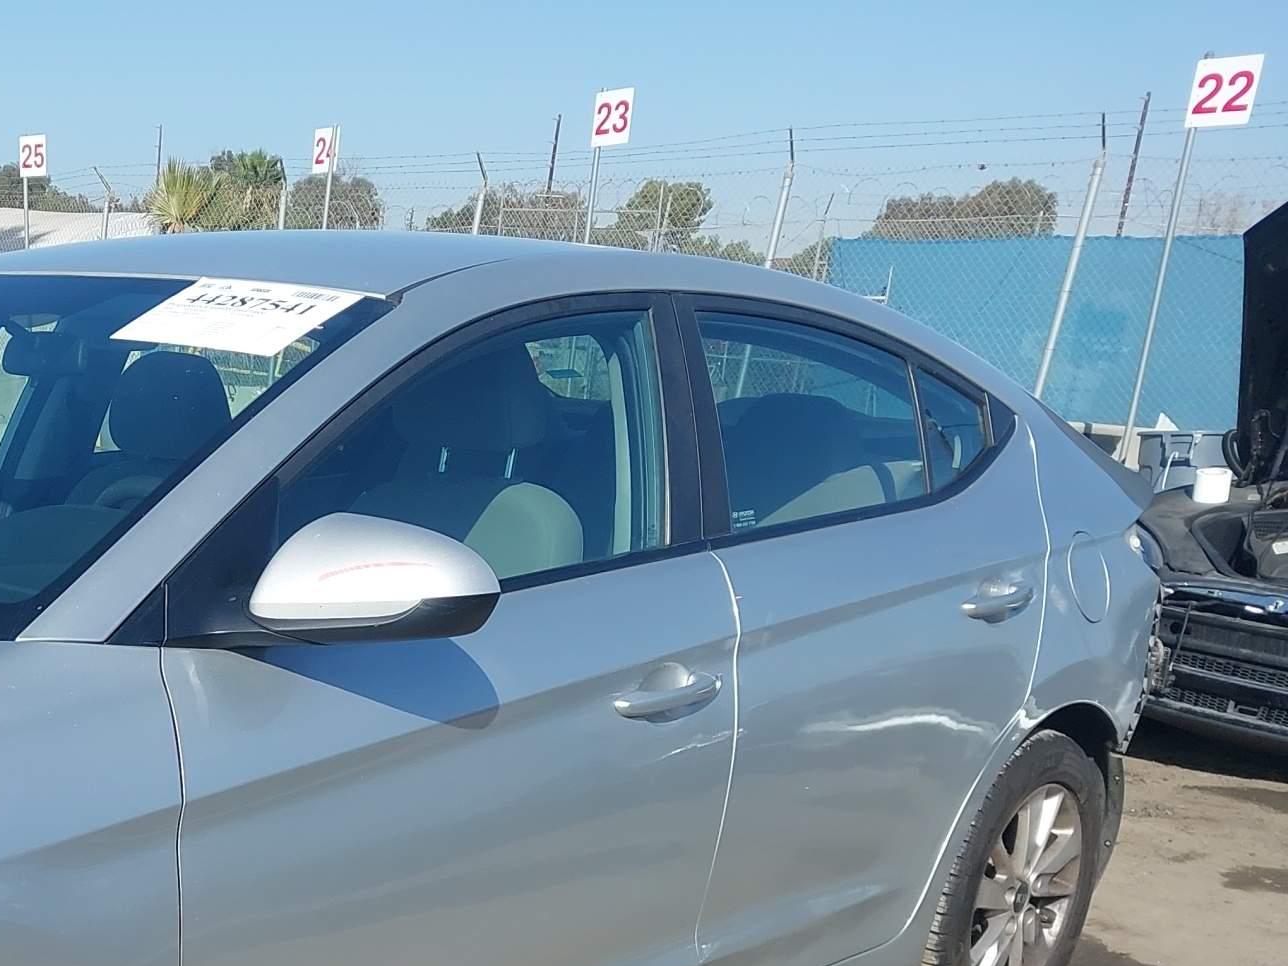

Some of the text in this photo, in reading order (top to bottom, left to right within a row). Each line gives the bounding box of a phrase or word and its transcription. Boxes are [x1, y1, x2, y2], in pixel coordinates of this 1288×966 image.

[1192, 70, 1255, 115] 22
[595, 100, 630, 136] 23
[22, 144, 44, 169] 25
[186, 293, 317, 315] 44287541
